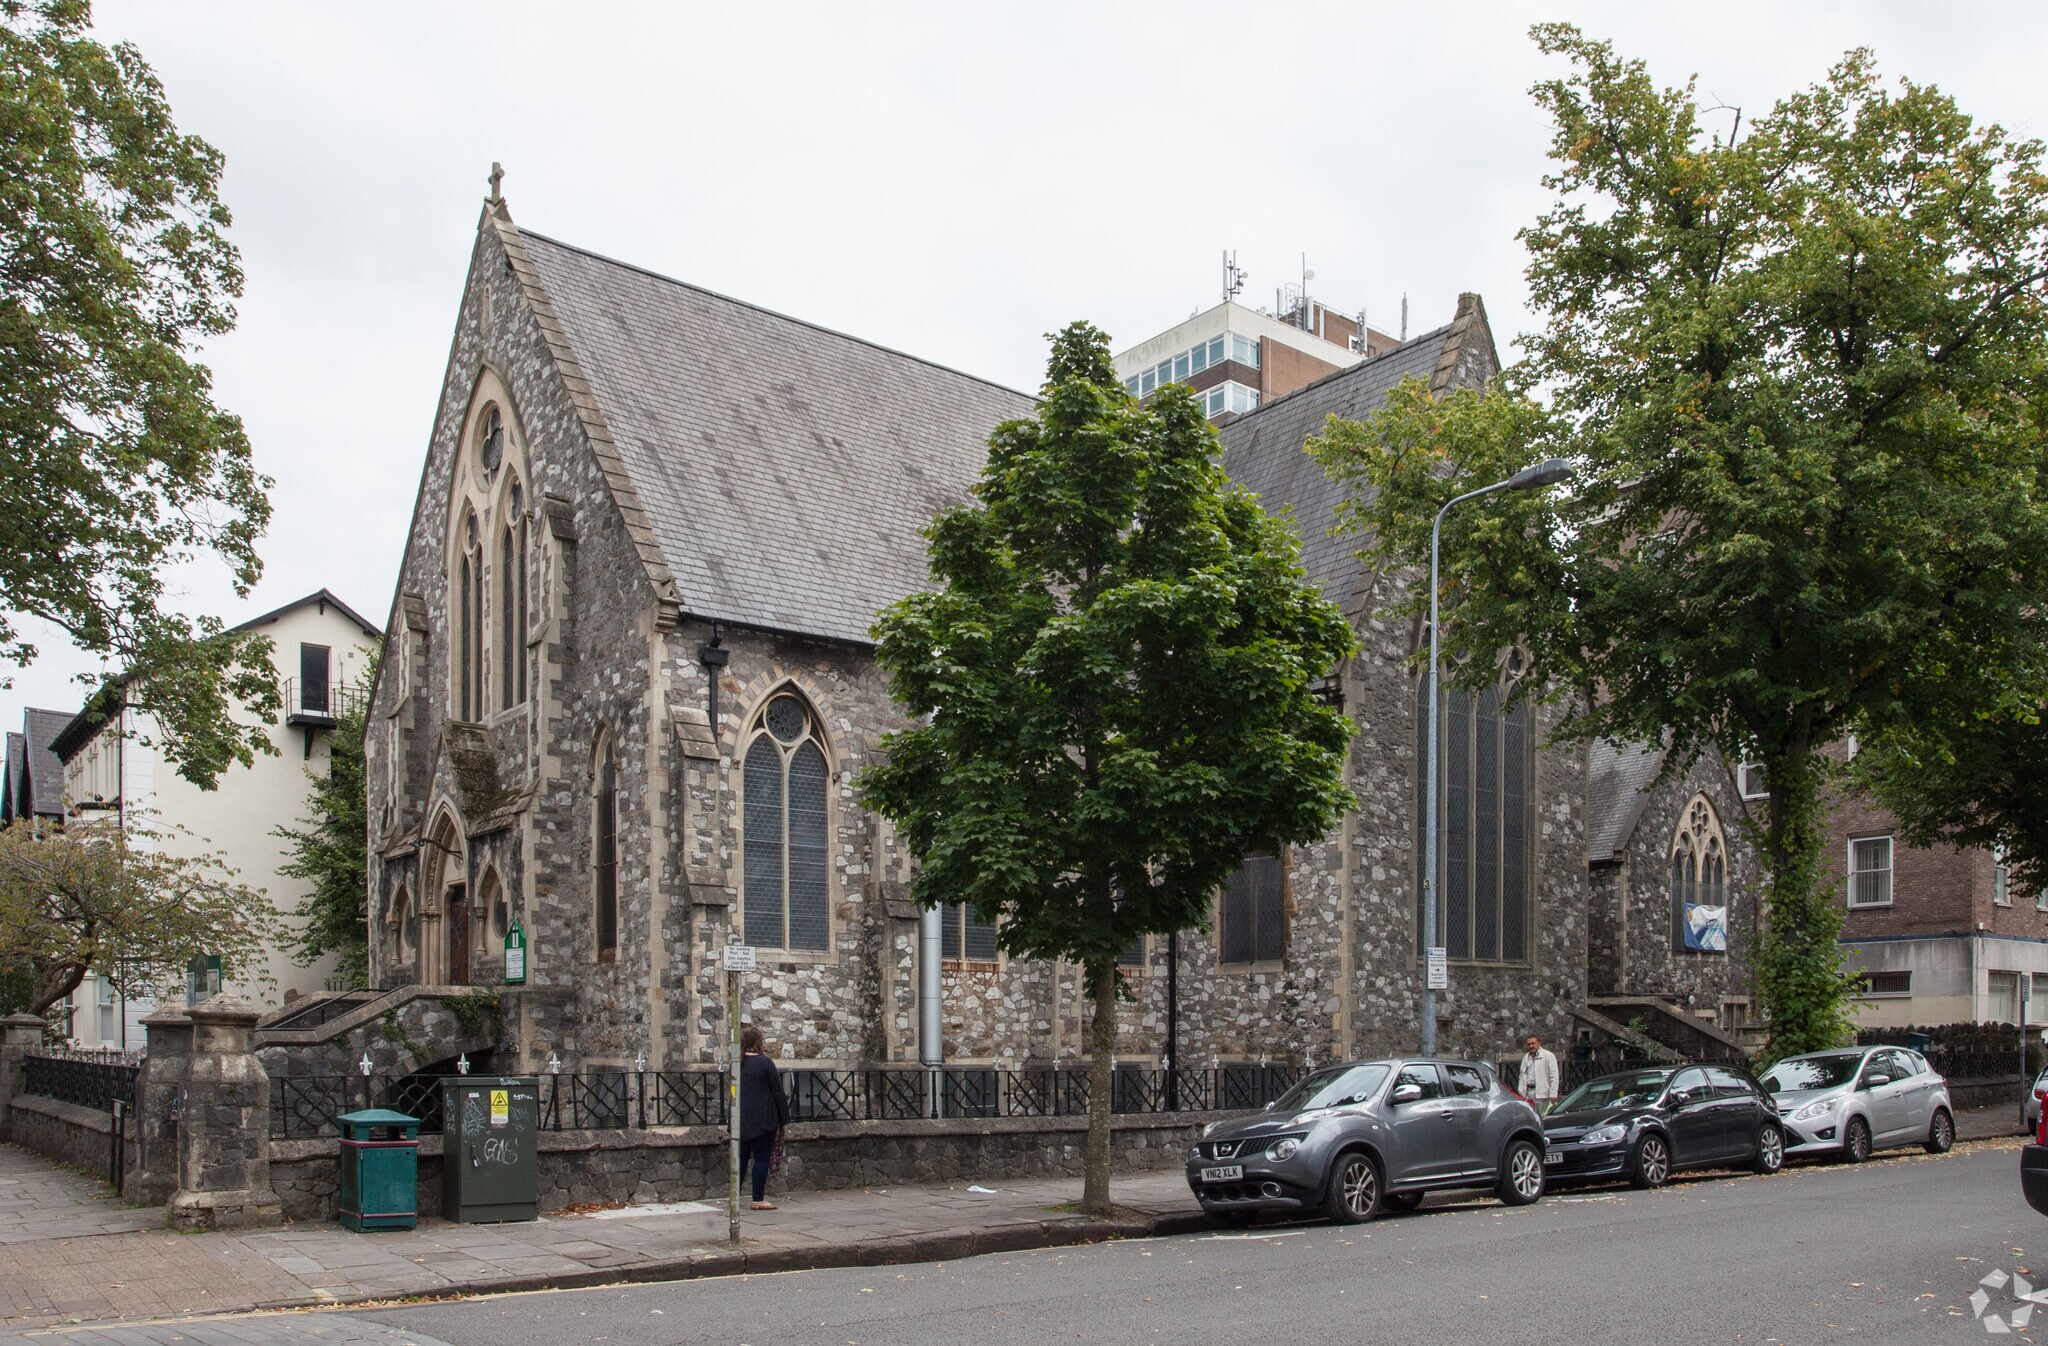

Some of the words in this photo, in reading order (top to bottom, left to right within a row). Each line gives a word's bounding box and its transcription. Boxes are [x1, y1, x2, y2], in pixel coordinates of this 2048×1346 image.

[1546, 1153, 1560, 1162] ETY
[1205, 1169, 1221, 1179] VN12
[1223, 1167, 1238, 1178] XLK
